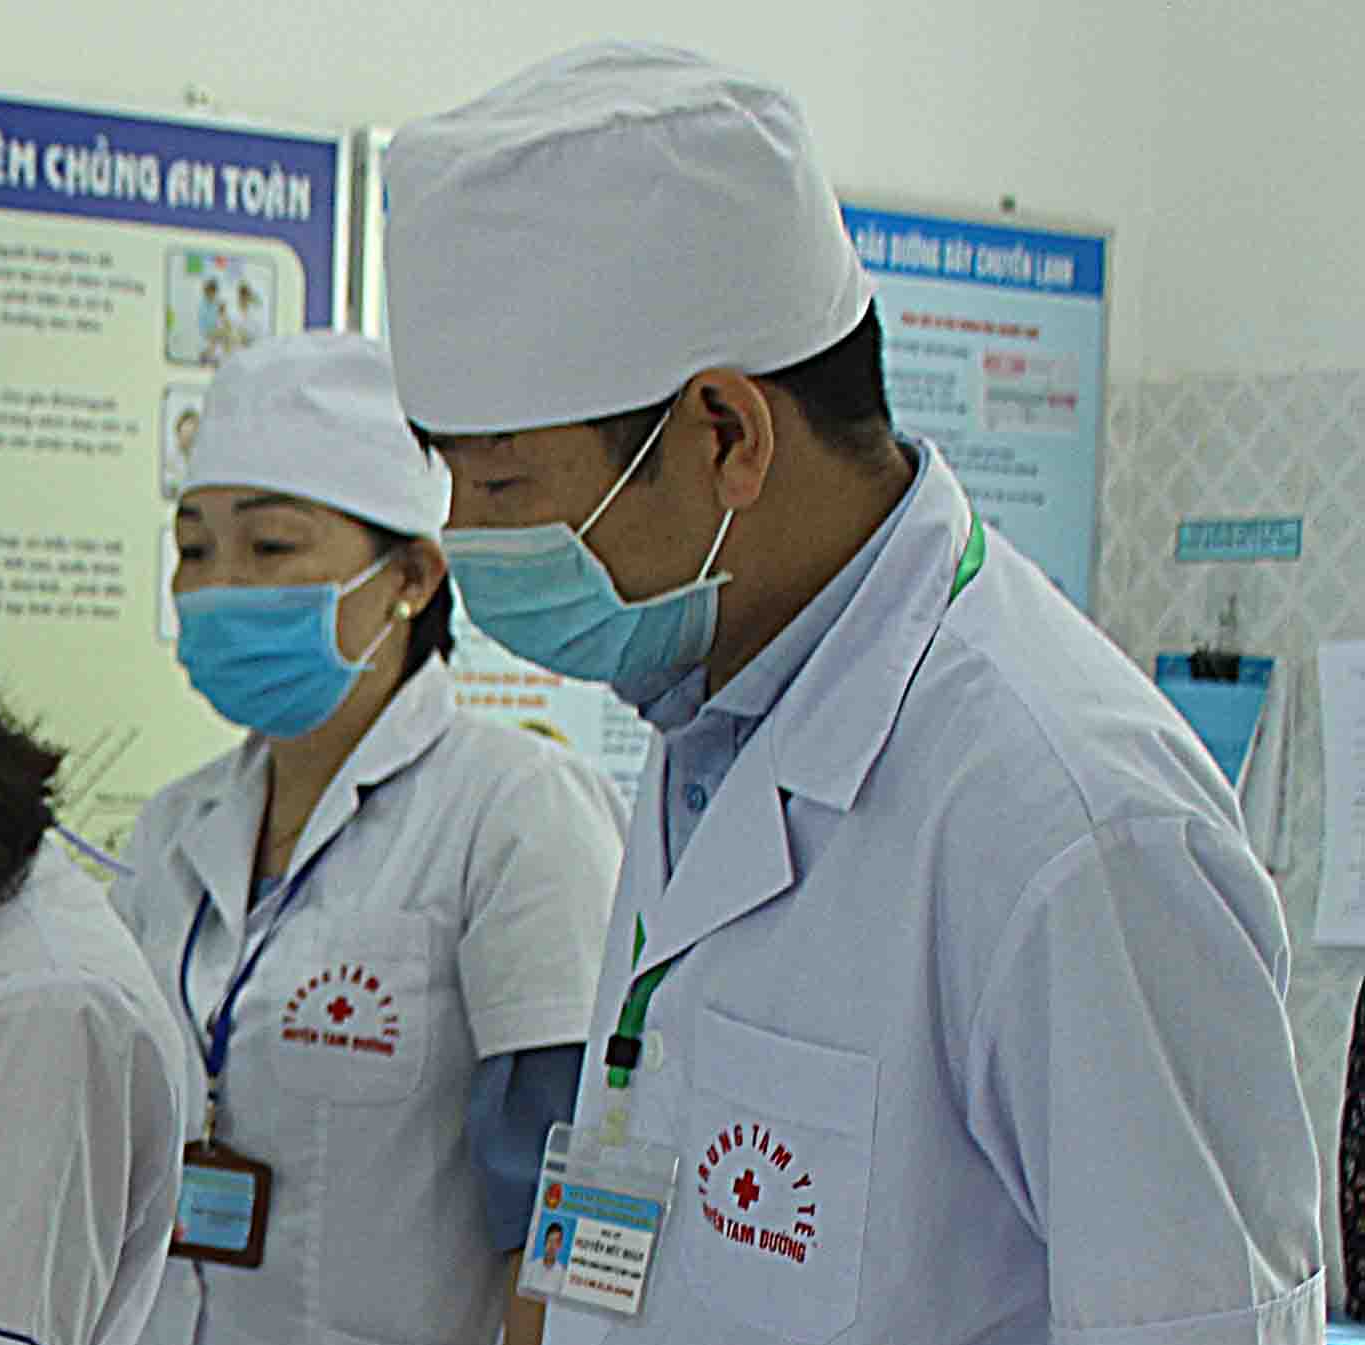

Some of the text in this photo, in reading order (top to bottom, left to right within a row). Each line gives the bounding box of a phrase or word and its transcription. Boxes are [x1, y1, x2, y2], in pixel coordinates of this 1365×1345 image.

[44, 134, 158, 201] CHỦNG
[167, 160, 214, 209] AN
[223, 161, 311, 221] TOÀN
[792, 1173, 812, 1191] Y
[726, 1218, 756, 1247] TAM
